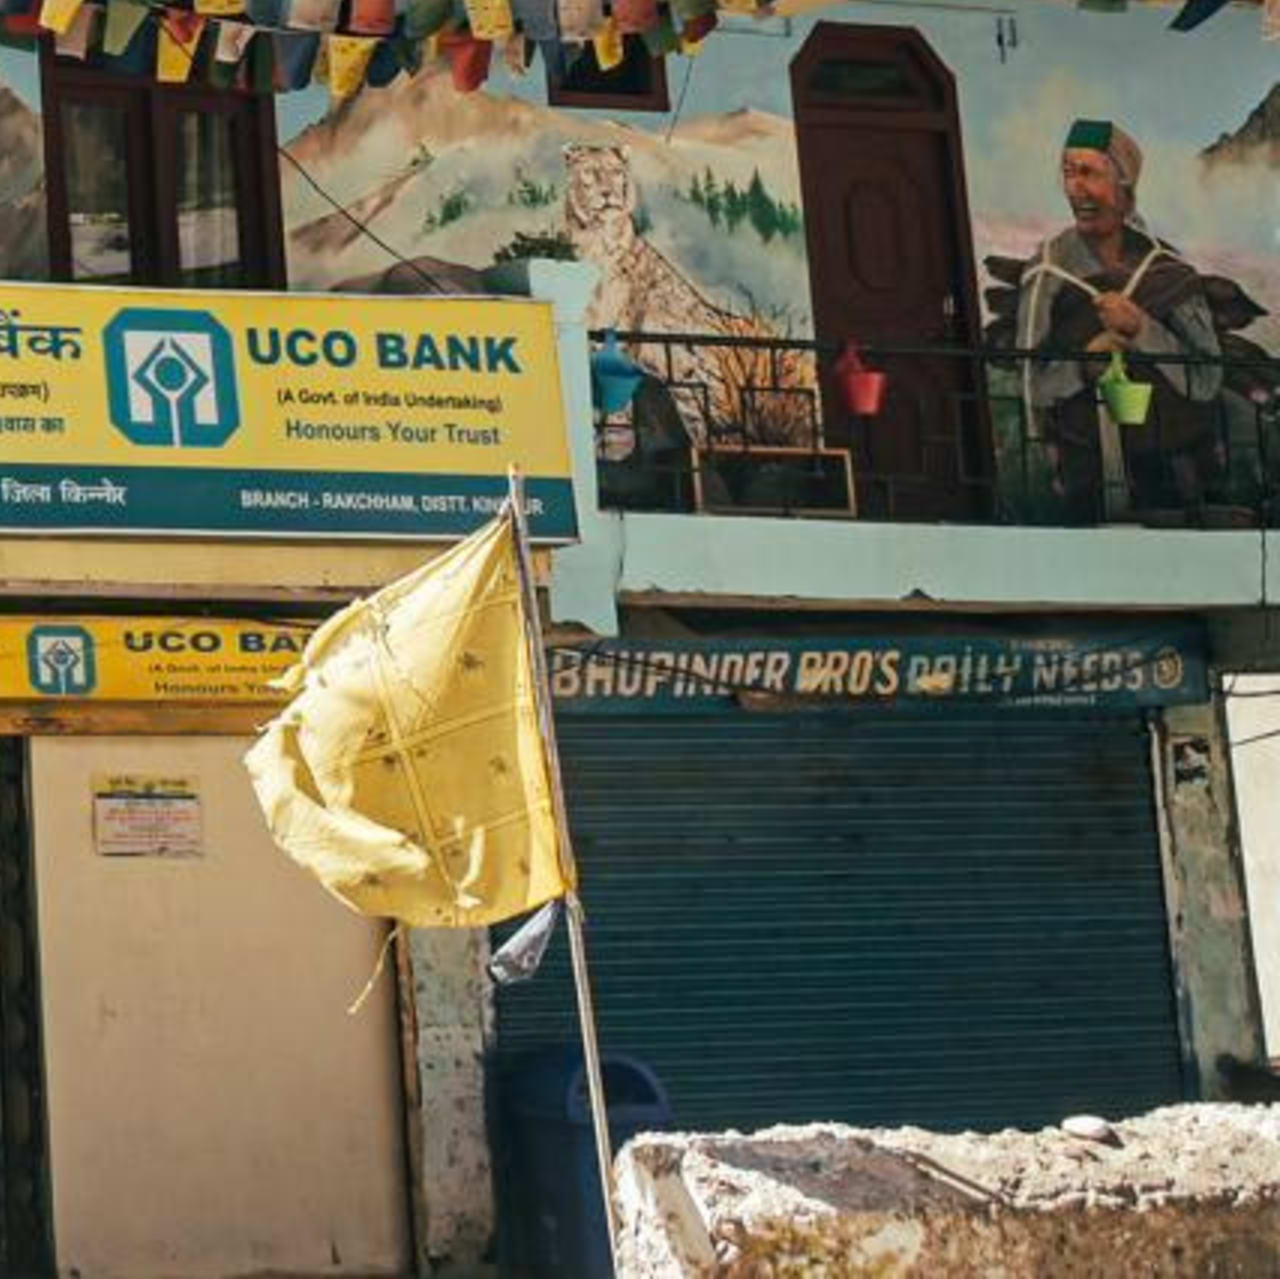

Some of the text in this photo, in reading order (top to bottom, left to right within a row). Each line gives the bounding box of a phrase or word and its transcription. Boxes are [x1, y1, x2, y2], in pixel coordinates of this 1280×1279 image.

[245, 326, 523, 374] UCO BANK
[298, 388, 340, 407] Govt.
[343, 391, 362, 406] of
[364, 392, 402, 408] India
[284, 420, 502, 446] Honours Your Trust
[240, 489, 309, 510] BRANCH
[124, 631, 310, 654] UCO BA
[551, 648, 790, 697] BHUPINDER
